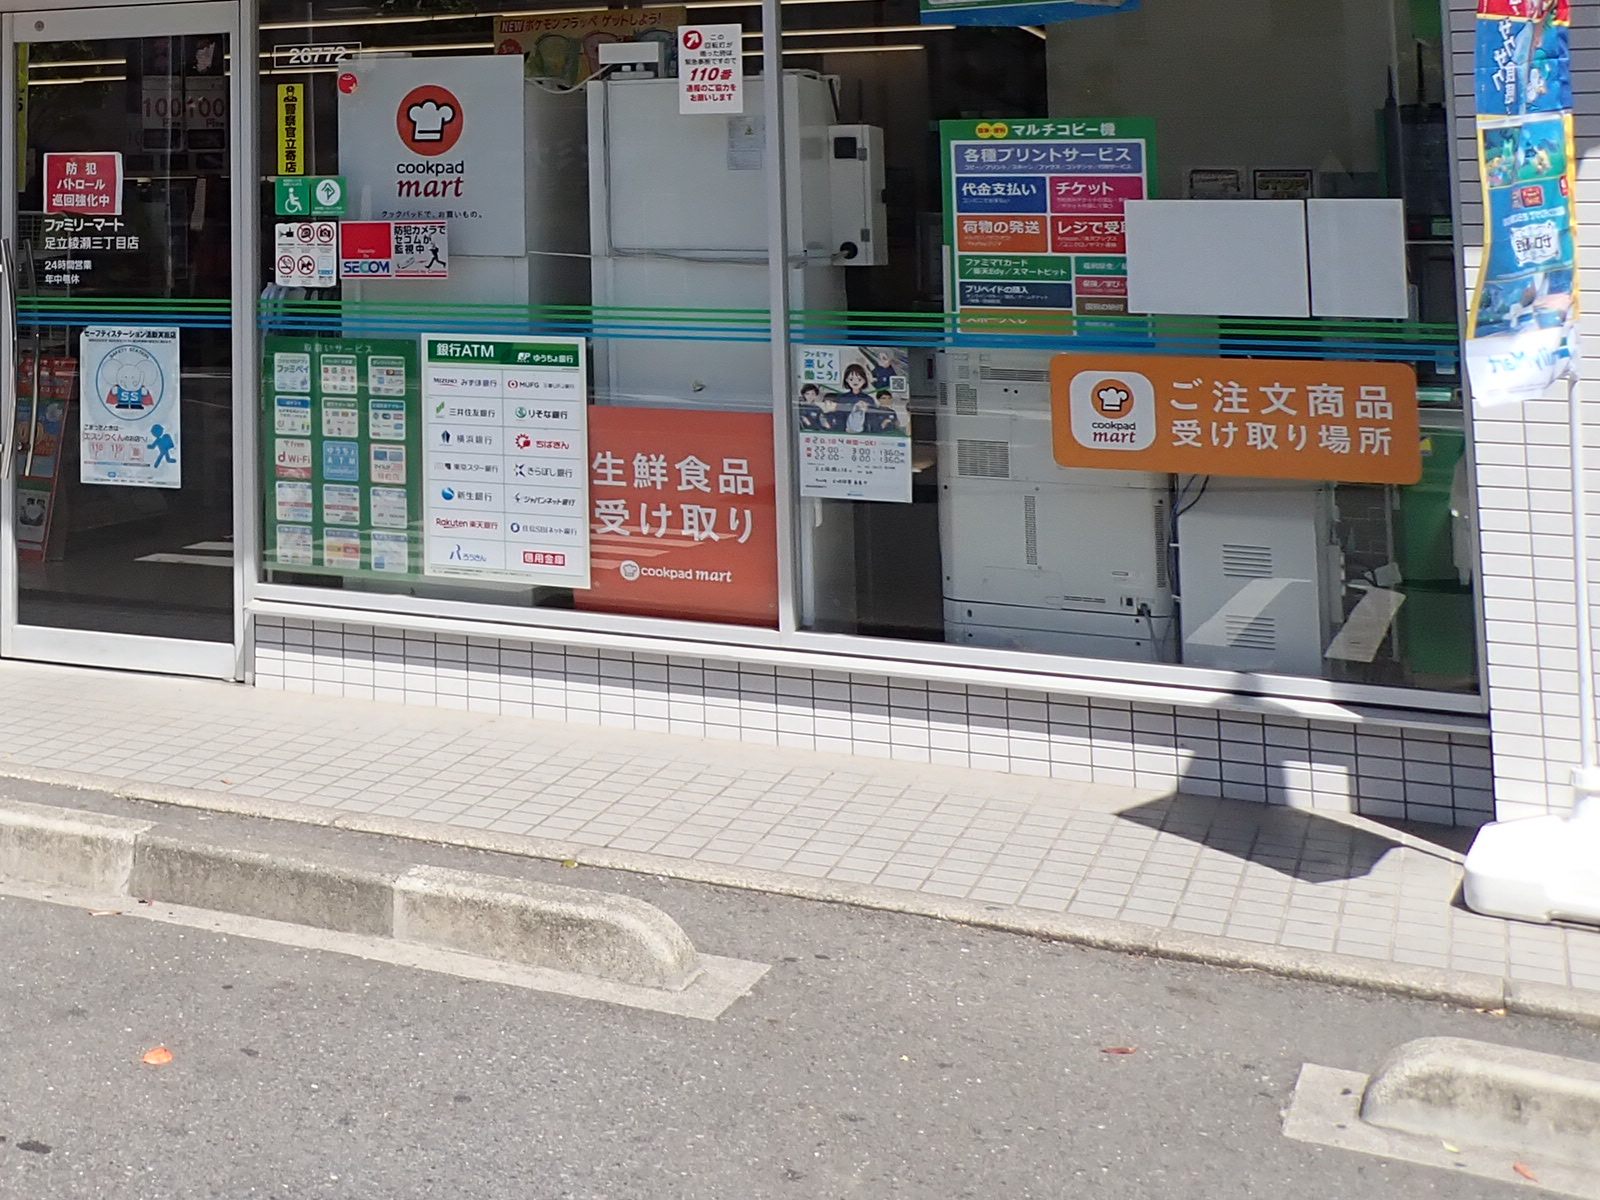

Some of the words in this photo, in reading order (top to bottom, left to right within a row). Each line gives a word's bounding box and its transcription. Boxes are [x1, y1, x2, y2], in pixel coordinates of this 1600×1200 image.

[288, 46, 347, 64] 26772
[1011, 122, 1116, 137] マルチコピー機
[284, 103, 297, 173] 警察官立寄店
[963, 147, 1131, 163] 各種プリントサービス
[65, 162, 97, 175] 防犯
[396, 160, 464, 178] cookpad
[56, 178, 106, 190] パトロール
[397, 176, 464, 198] mart
[962, 182, 1037, 196] 代金支払い
[1056, 182, 1114, 196] チケット
[52, 193, 110, 207] 巡回強化中
[44, 218, 124, 232] ファミリーマート
[394, 225, 446, 235] 防犯カメラで
[962, 220, 1040, 235] 荷物の発送
[44, 236, 140, 250] 足立綾瀬三丁目店
[395, 236, 431, 244] セコムが
[395, 245, 424, 254] 監視中
[44, 260, 92, 270] 24時間営業
[344, 261, 390, 273] SECOM
[436, 343, 495, 358] 銀行ATM
[804, 359, 833, 369] 楽しく
[120, 392, 139, 401] SS
[1170, 377, 1394, 420] ご注文商品
[449, 408, 495, 418] 三井住友銀行
[528, 409, 568, 419] りそな銀行
[1092, 420, 1136, 432] cookpad
[456, 435, 492, 445] 横浜銀行
[1093, 431, 1136, 444] mart
[1171, 419, 1393, 456] 受け取り場所
[288, 455, 310, 464] Wi-Fi
[527, 467, 573, 478] きらぼし銀行
[592, 451, 754, 496] 生鮮食品
[457, 490, 492, 501] 新生銀行
[435, 518, 468, 528] Rakuten
[594, 499, 754, 544] 受け取り
[641, 565, 693, 582] cookpad
[695, 567, 732, 583] mart
